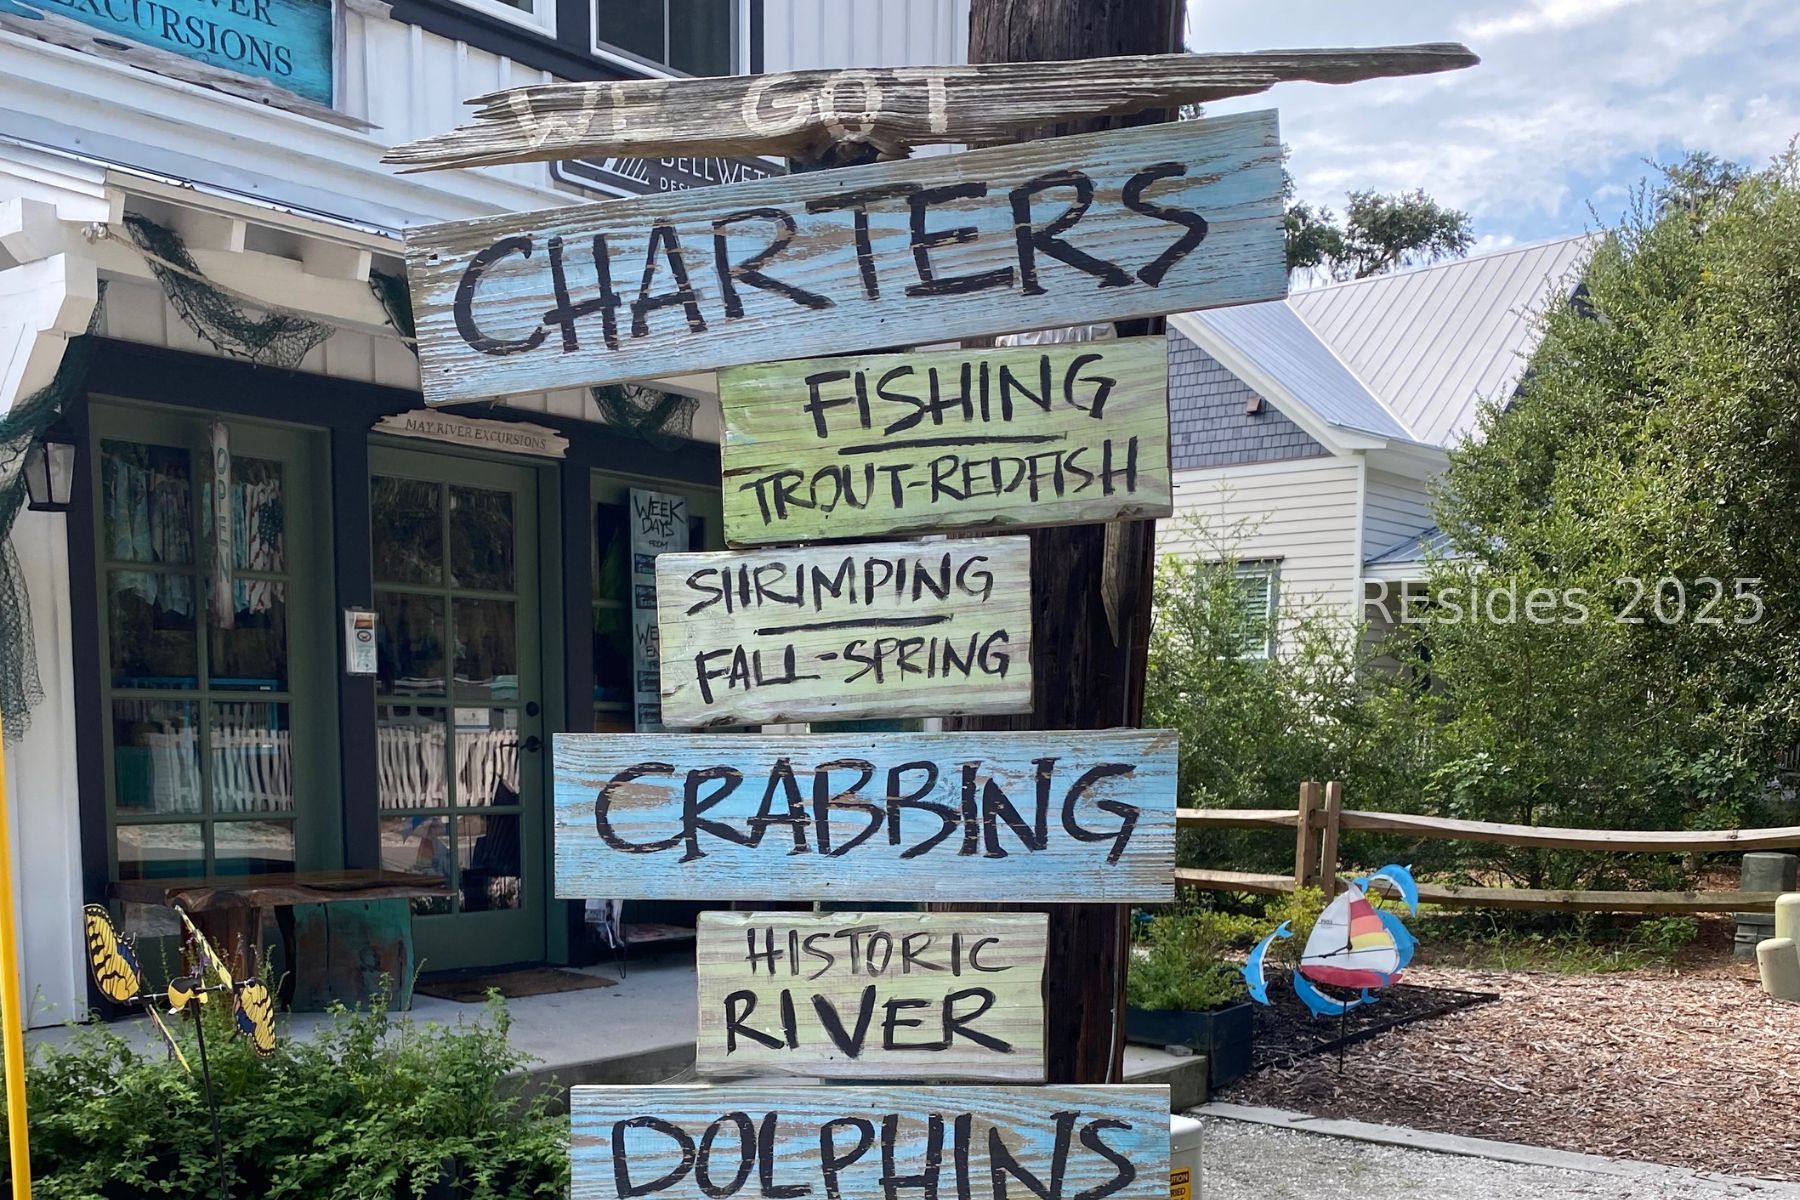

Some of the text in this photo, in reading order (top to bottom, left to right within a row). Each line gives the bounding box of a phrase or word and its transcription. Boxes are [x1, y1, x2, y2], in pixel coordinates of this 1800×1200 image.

[509, 68, 978, 147] WE GOT
[453, 160, 1208, 356] CHARTERS
[405, 418, 547, 450] MAY RIVER EXCURSIONS
[803, 354, 1117, 438] FISHING
[217, 447, 231, 584] OPEN
[633, 495, 685, 525] WEEK
[739, 435, 1139, 526] TROUT-REDFISH
[641, 517, 675, 538] DAYS
[686, 552, 994, 616] SHRIMPING
[695, 628, 1011, 704] FALL-SPRING
[595, 757, 1142, 866] CRABBING
[745, 925, 1012, 981] HISTORIC
[723, 983, 1013, 1060] RIVER
[612, 1109, 1136, 1200] DOLPHINS
